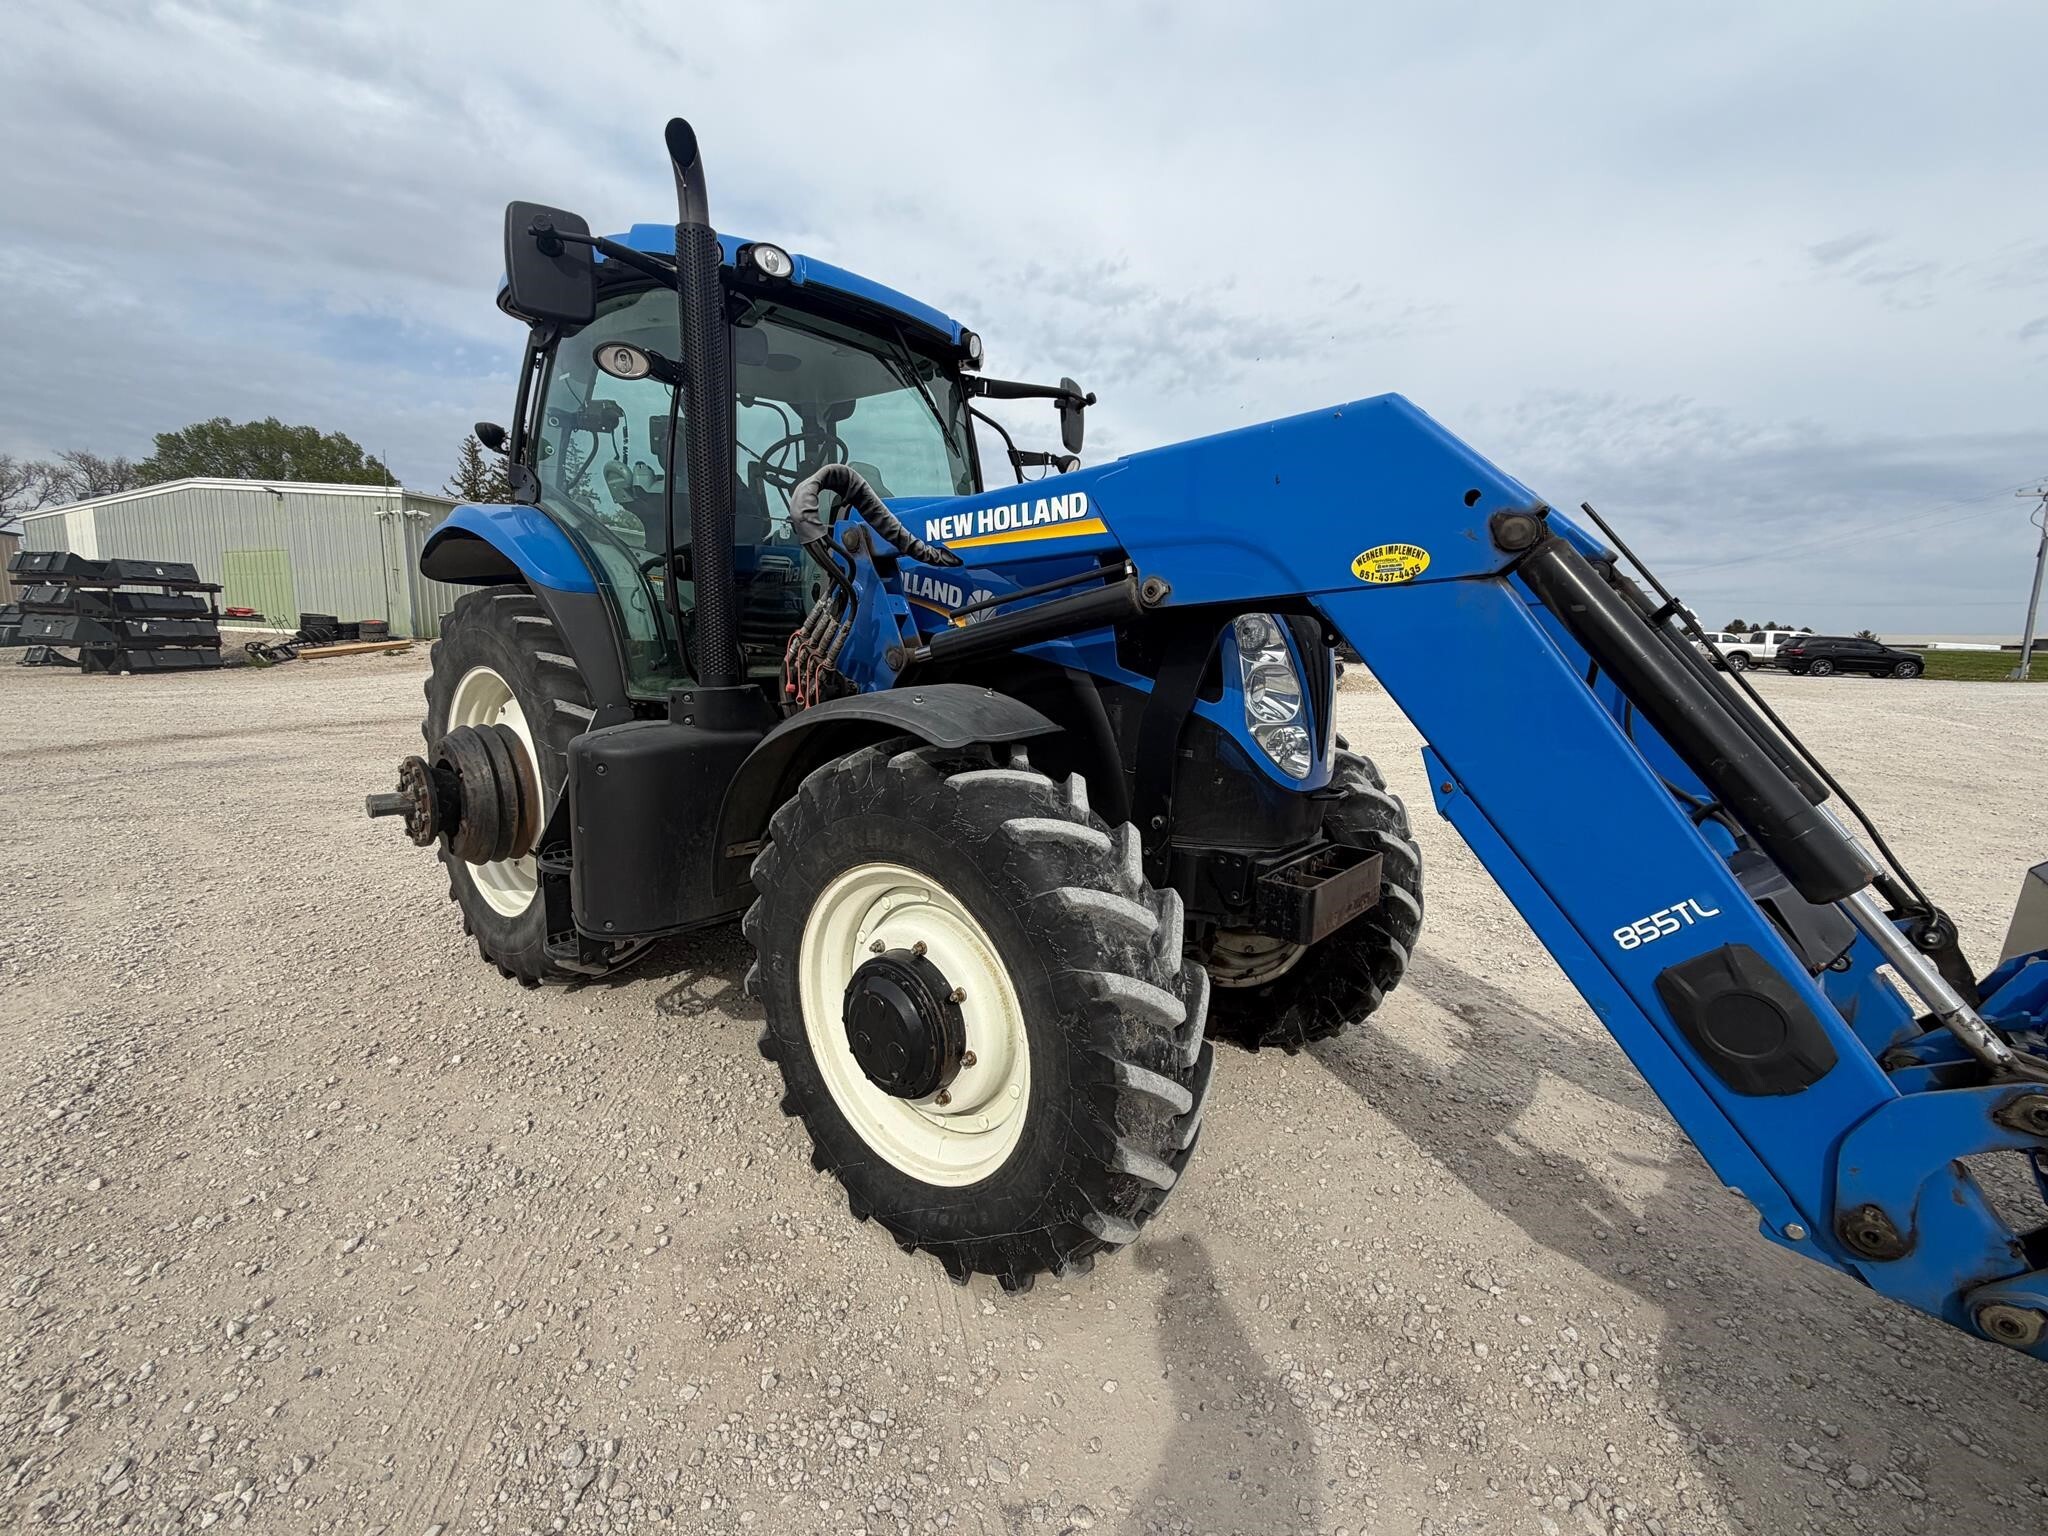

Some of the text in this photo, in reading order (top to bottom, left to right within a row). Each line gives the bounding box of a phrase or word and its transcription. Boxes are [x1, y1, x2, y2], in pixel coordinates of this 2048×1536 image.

[926, 492, 1089, 541] NEW HOLLAND
[1355, 545, 1425, 567] WERNER IMPLEMENT
[1360, 564, 1421, 582] 651-437-4435
[900, 571, 963, 608] LLAND
[1613, 898, 1720, 950] 855TL
